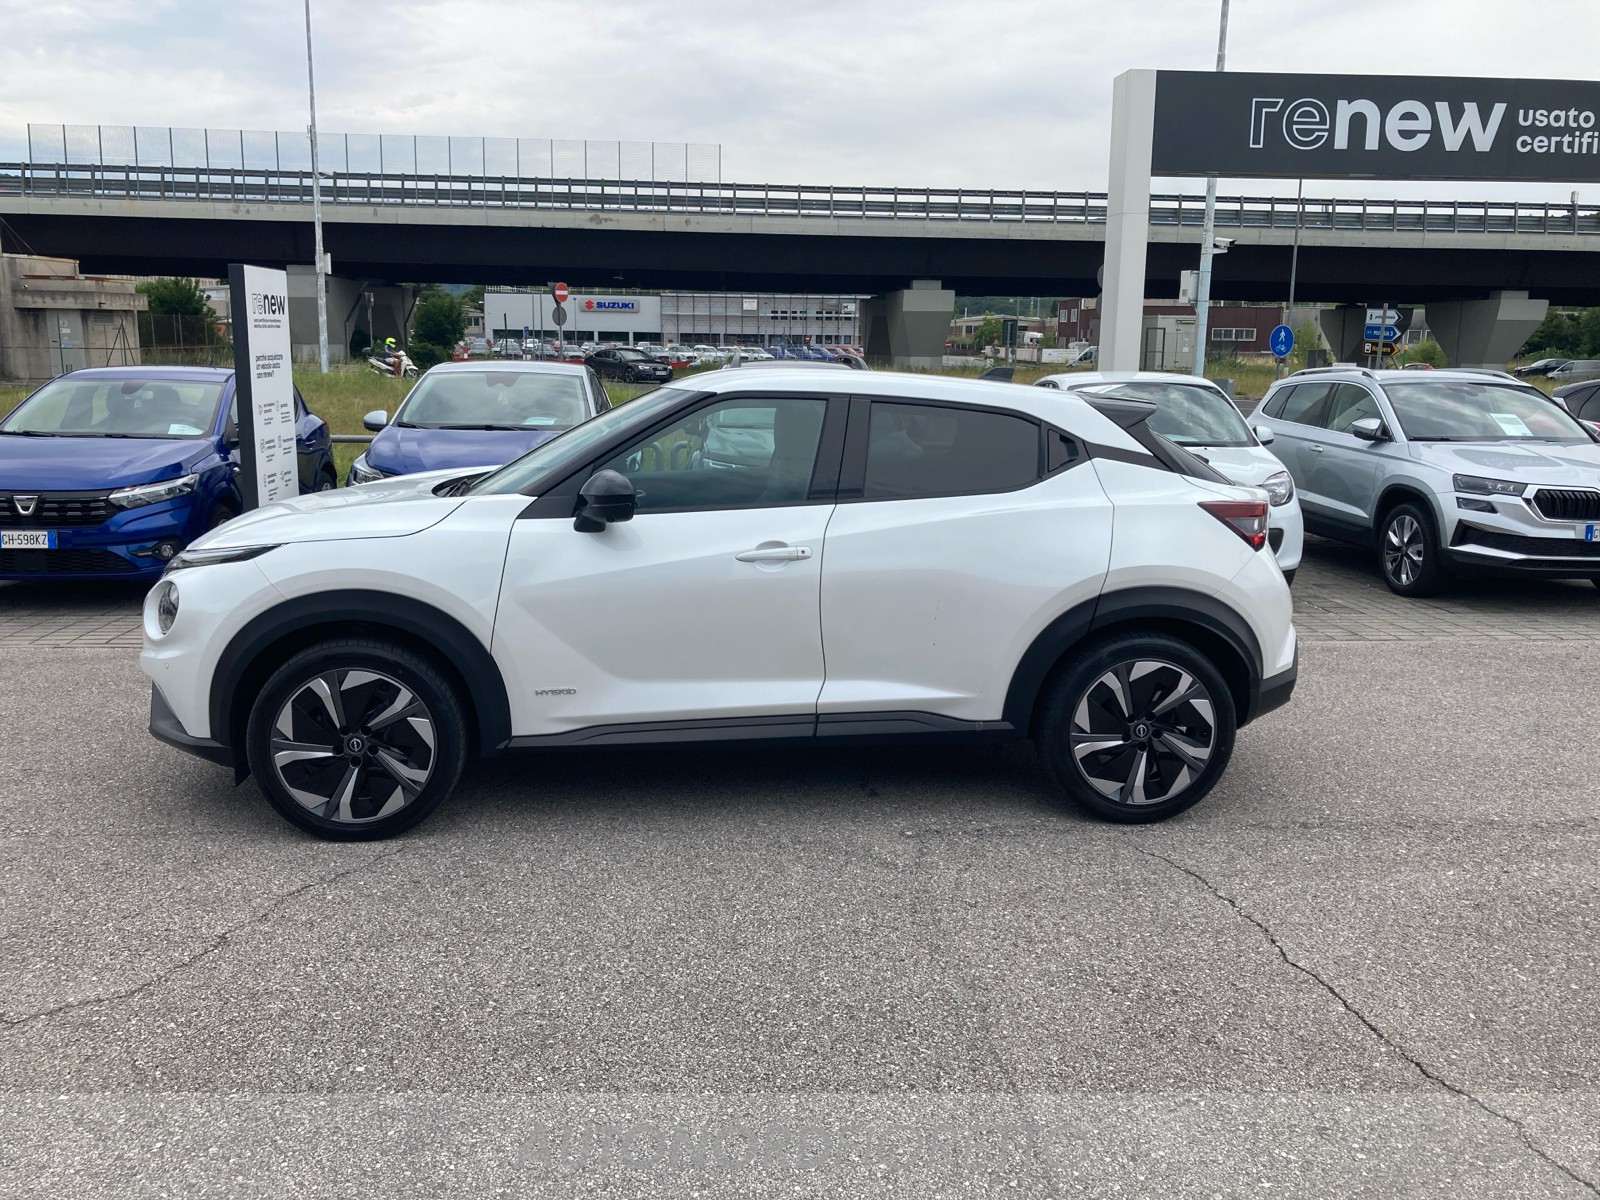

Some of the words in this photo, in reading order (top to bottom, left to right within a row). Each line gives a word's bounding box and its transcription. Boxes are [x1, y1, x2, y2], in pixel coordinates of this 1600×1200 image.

[1249, 97, 1508, 152] renew
[1518, 107, 1596, 128] usato
[252, 293, 286, 315] renew
[596, 301, 635, 309] SUZUKI
[535, 688, 577, 696] HYBRID
